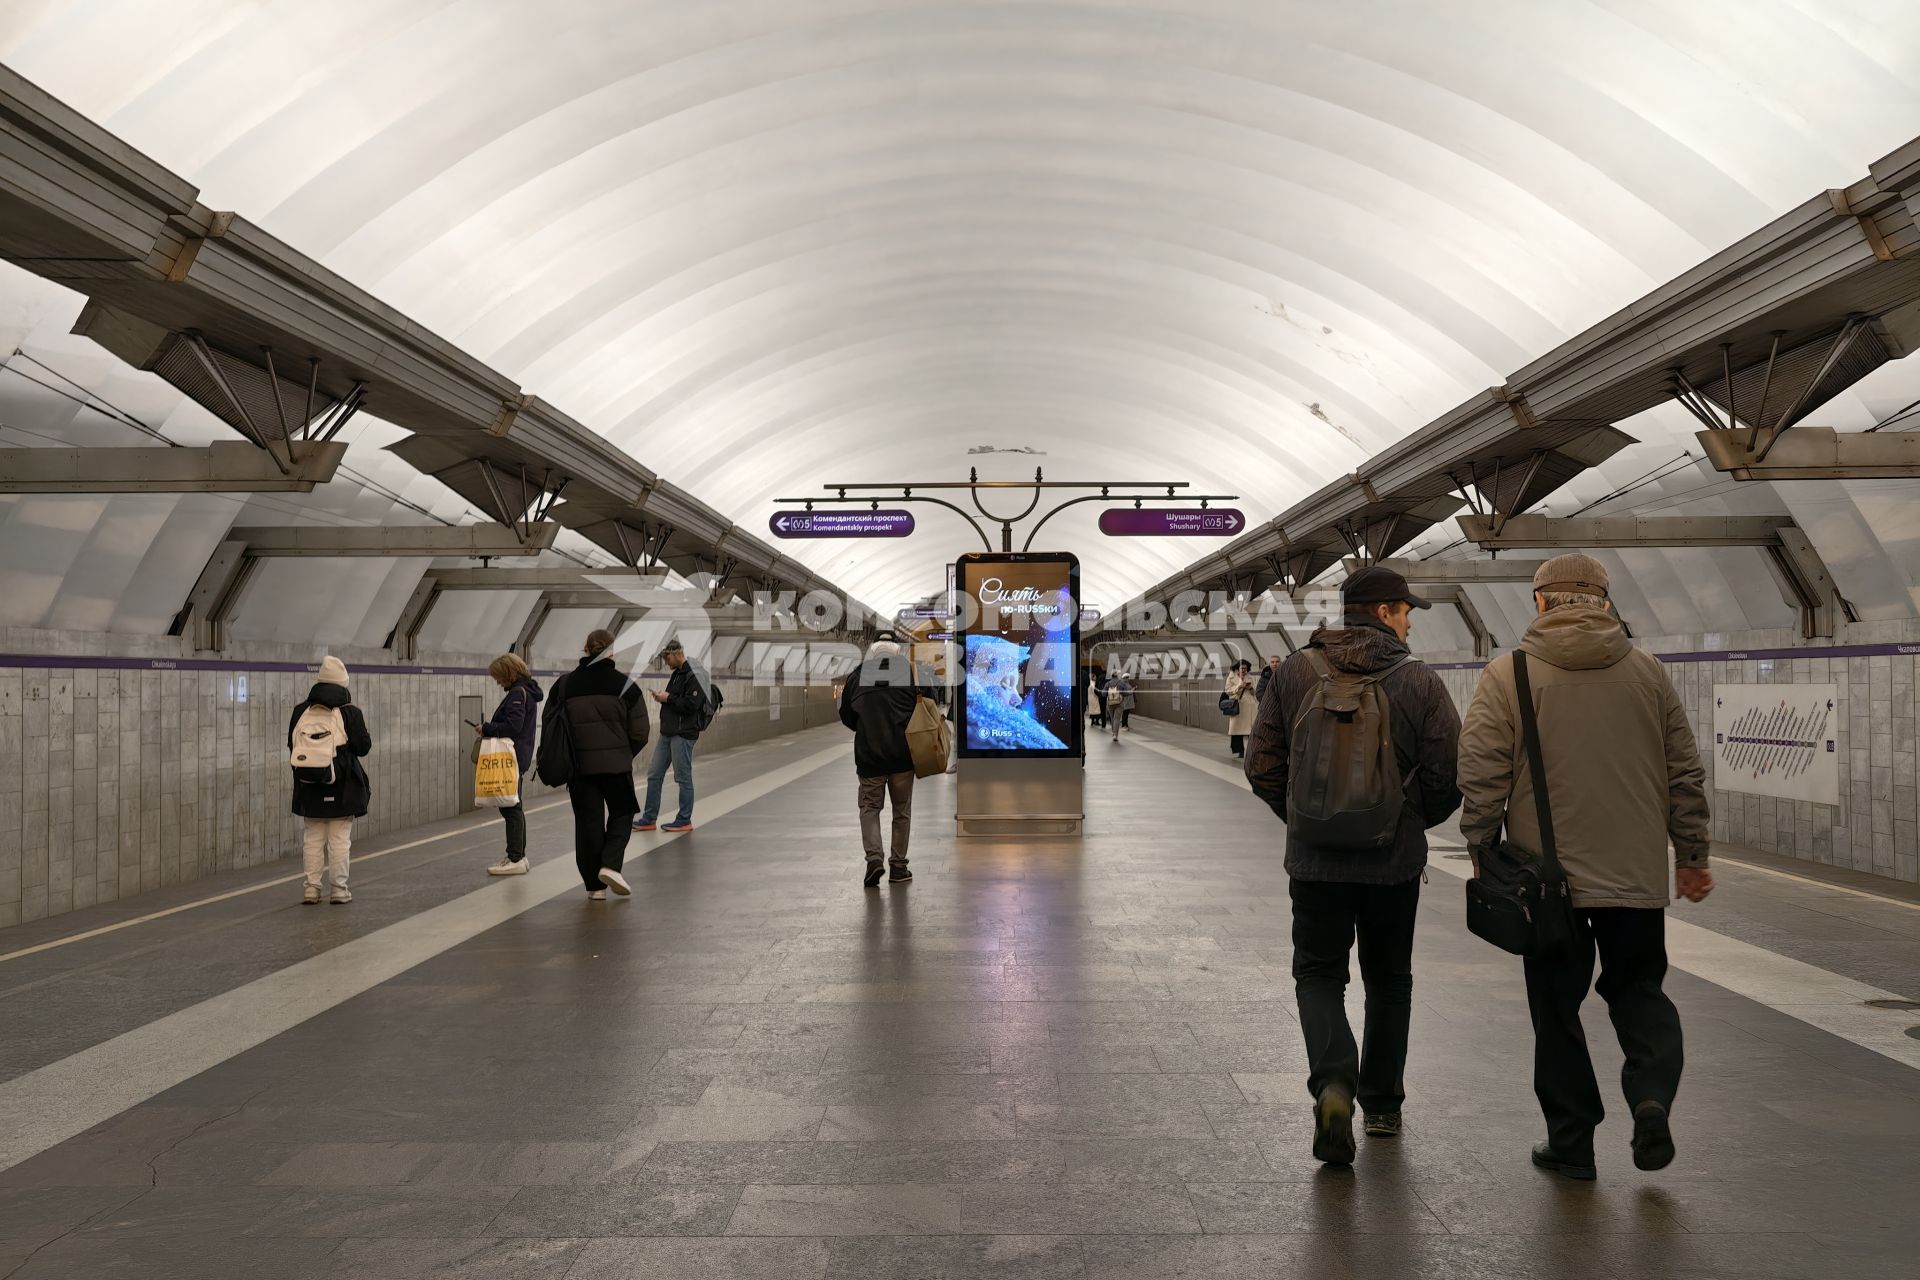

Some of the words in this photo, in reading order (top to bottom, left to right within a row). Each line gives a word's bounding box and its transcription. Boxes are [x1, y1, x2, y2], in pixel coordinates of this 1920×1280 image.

[813, 514, 872, 523] Комендантский
[873, 515, 907, 523] проспект
[1166, 513, 1201, 522] Шушары
[813, 524, 862, 532] Komendantskiy
[863, 524, 892, 532] prospekt
[1169, 523, 1201, 531] Shushary
[979, 577, 1043, 605] Сиять
